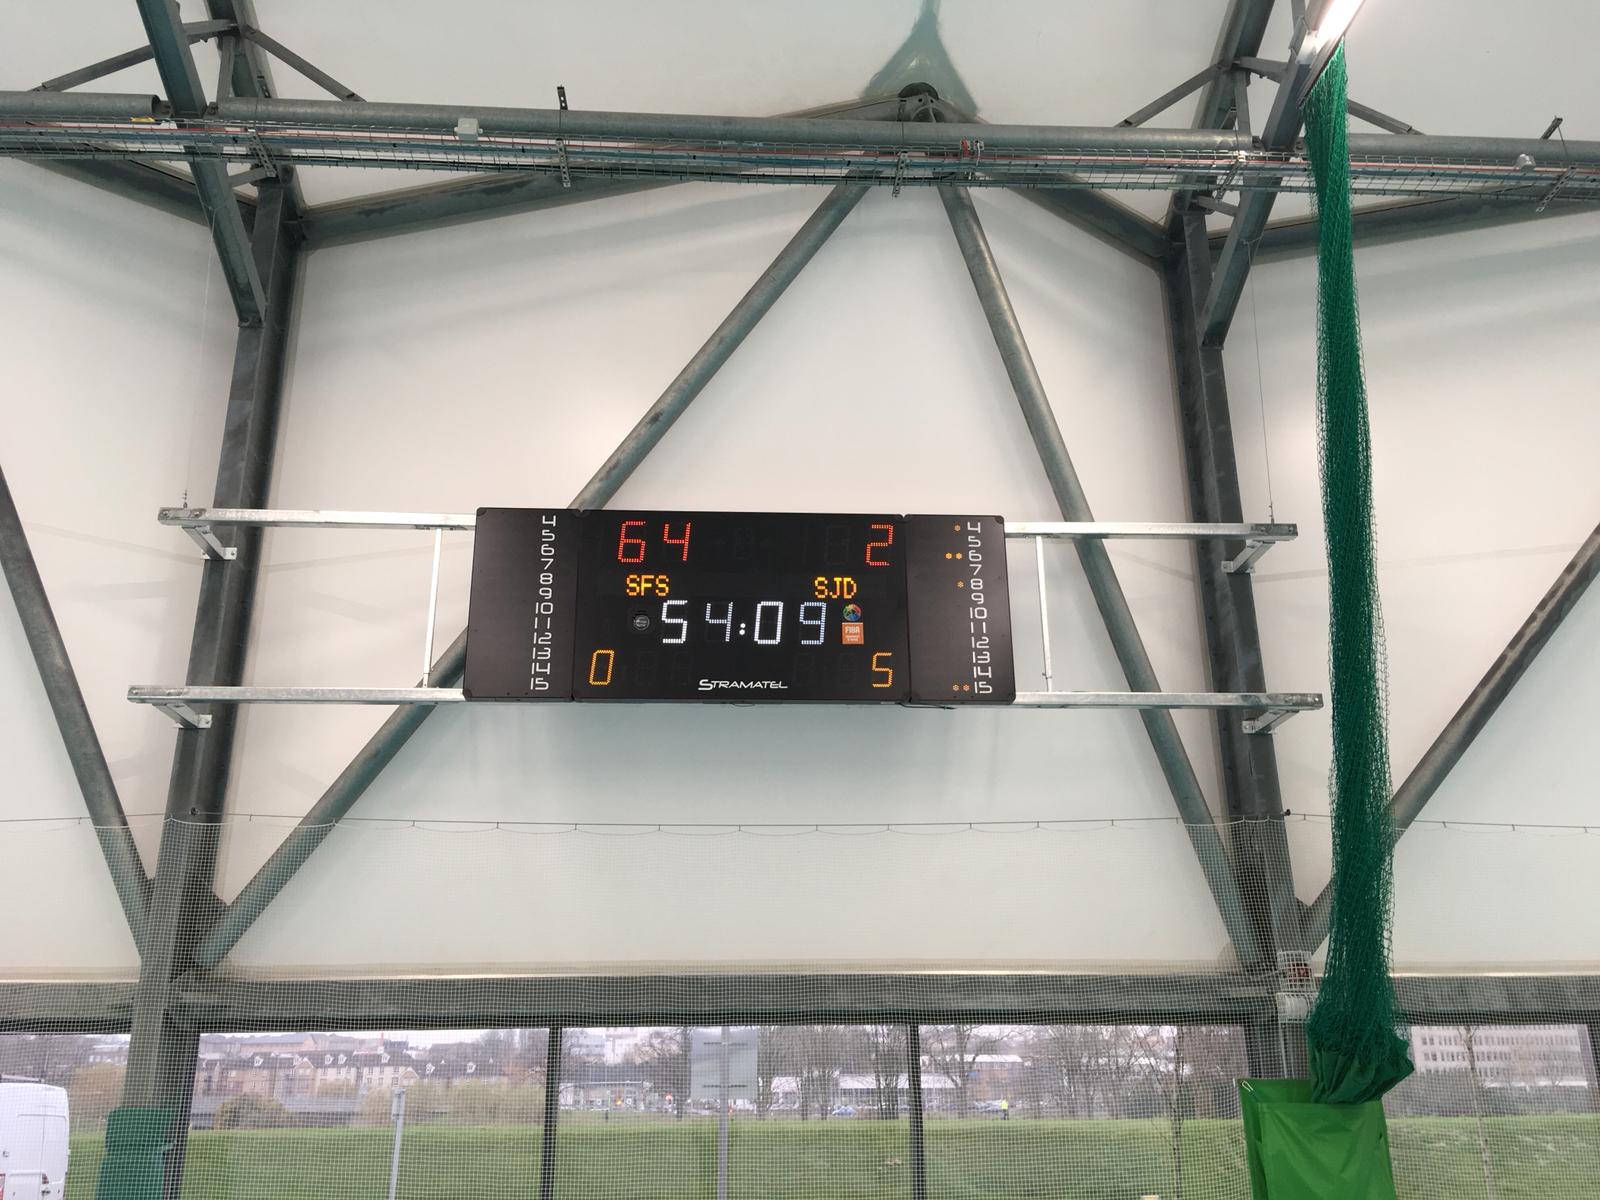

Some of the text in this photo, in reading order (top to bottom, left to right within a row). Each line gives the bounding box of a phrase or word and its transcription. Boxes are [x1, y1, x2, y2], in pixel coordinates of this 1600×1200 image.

[542, 516, 556, 527] 4
[968, 521, 981, 533] 4
[542, 530, 555, 541] 5
[617, 521, 692, 563] 64
[865, 525, 893, 566] 2
[968, 536, 981, 547] 5
[541, 544, 555, 556] 6
[968, 550, 982, 561] 6
[542, 559, 554, 570] 7
[971, 564, 982, 576] 7
[540, 574, 552, 584] 8
[971, 579, 983, 590] 8
[625, 574, 670, 597] SFS
[814, 576, 858, 599] SJD
[539, 588, 552, 599] 9
[971, 593, 984, 604] 9
[535, 602, 553, 615] 10
[970, 607, 987, 619] 10
[534, 618, 550, 629] 11
[661, 600, 827, 645] 54:09
[971, 622, 986, 633] 11
[533, 633, 551, 644] 12
[971, 637, 989, 648] 12
[532, 647, 551, 659] 13
[972, 651, 990, 664] 13
[532, 663, 550, 674] 14
[589, 649, 615, 685] 0
[872, 652, 893, 688] 5
[973, 667, 992, 678] 14
[530, 678, 549, 689] 15
[698, 679, 788, 691] STRAMATEL
[974, 682, 992, 694] 15
